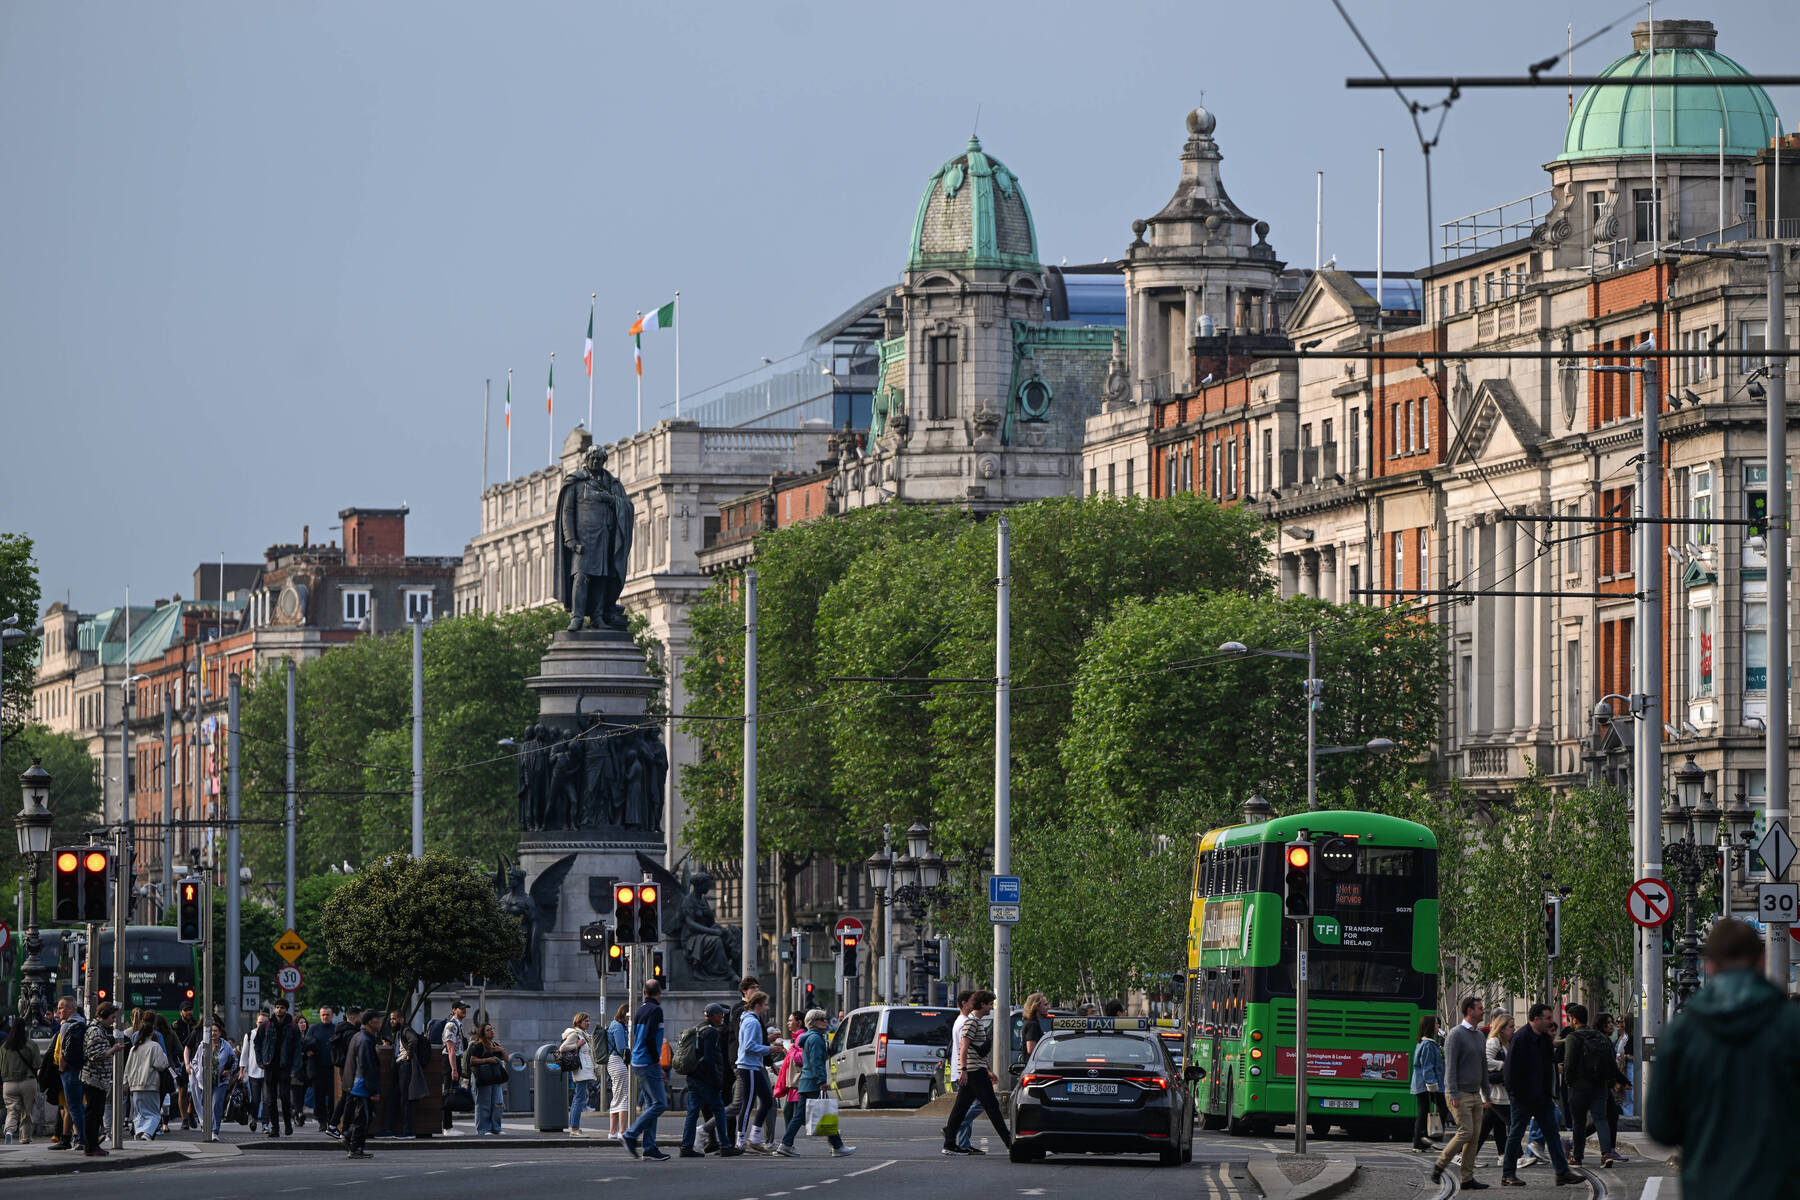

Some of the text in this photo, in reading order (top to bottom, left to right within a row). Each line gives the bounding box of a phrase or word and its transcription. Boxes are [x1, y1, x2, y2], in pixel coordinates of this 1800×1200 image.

[1335, 895, 1362, 904] Service
[1764, 895, 1793, 912] 30
[1316, 924, 1338, 936] TFI
[1344, 925, 1384, 934] TRANSPORT
[1343, 939, 1372, 947] IRELAND
[283, 971, 297, 983] 30
[245, 997, 256, 1006] 15
[1060, 1018, 1146, 1029] 26256 TAXI D
[1306, 1052, 1332, 1060] Birmingham
